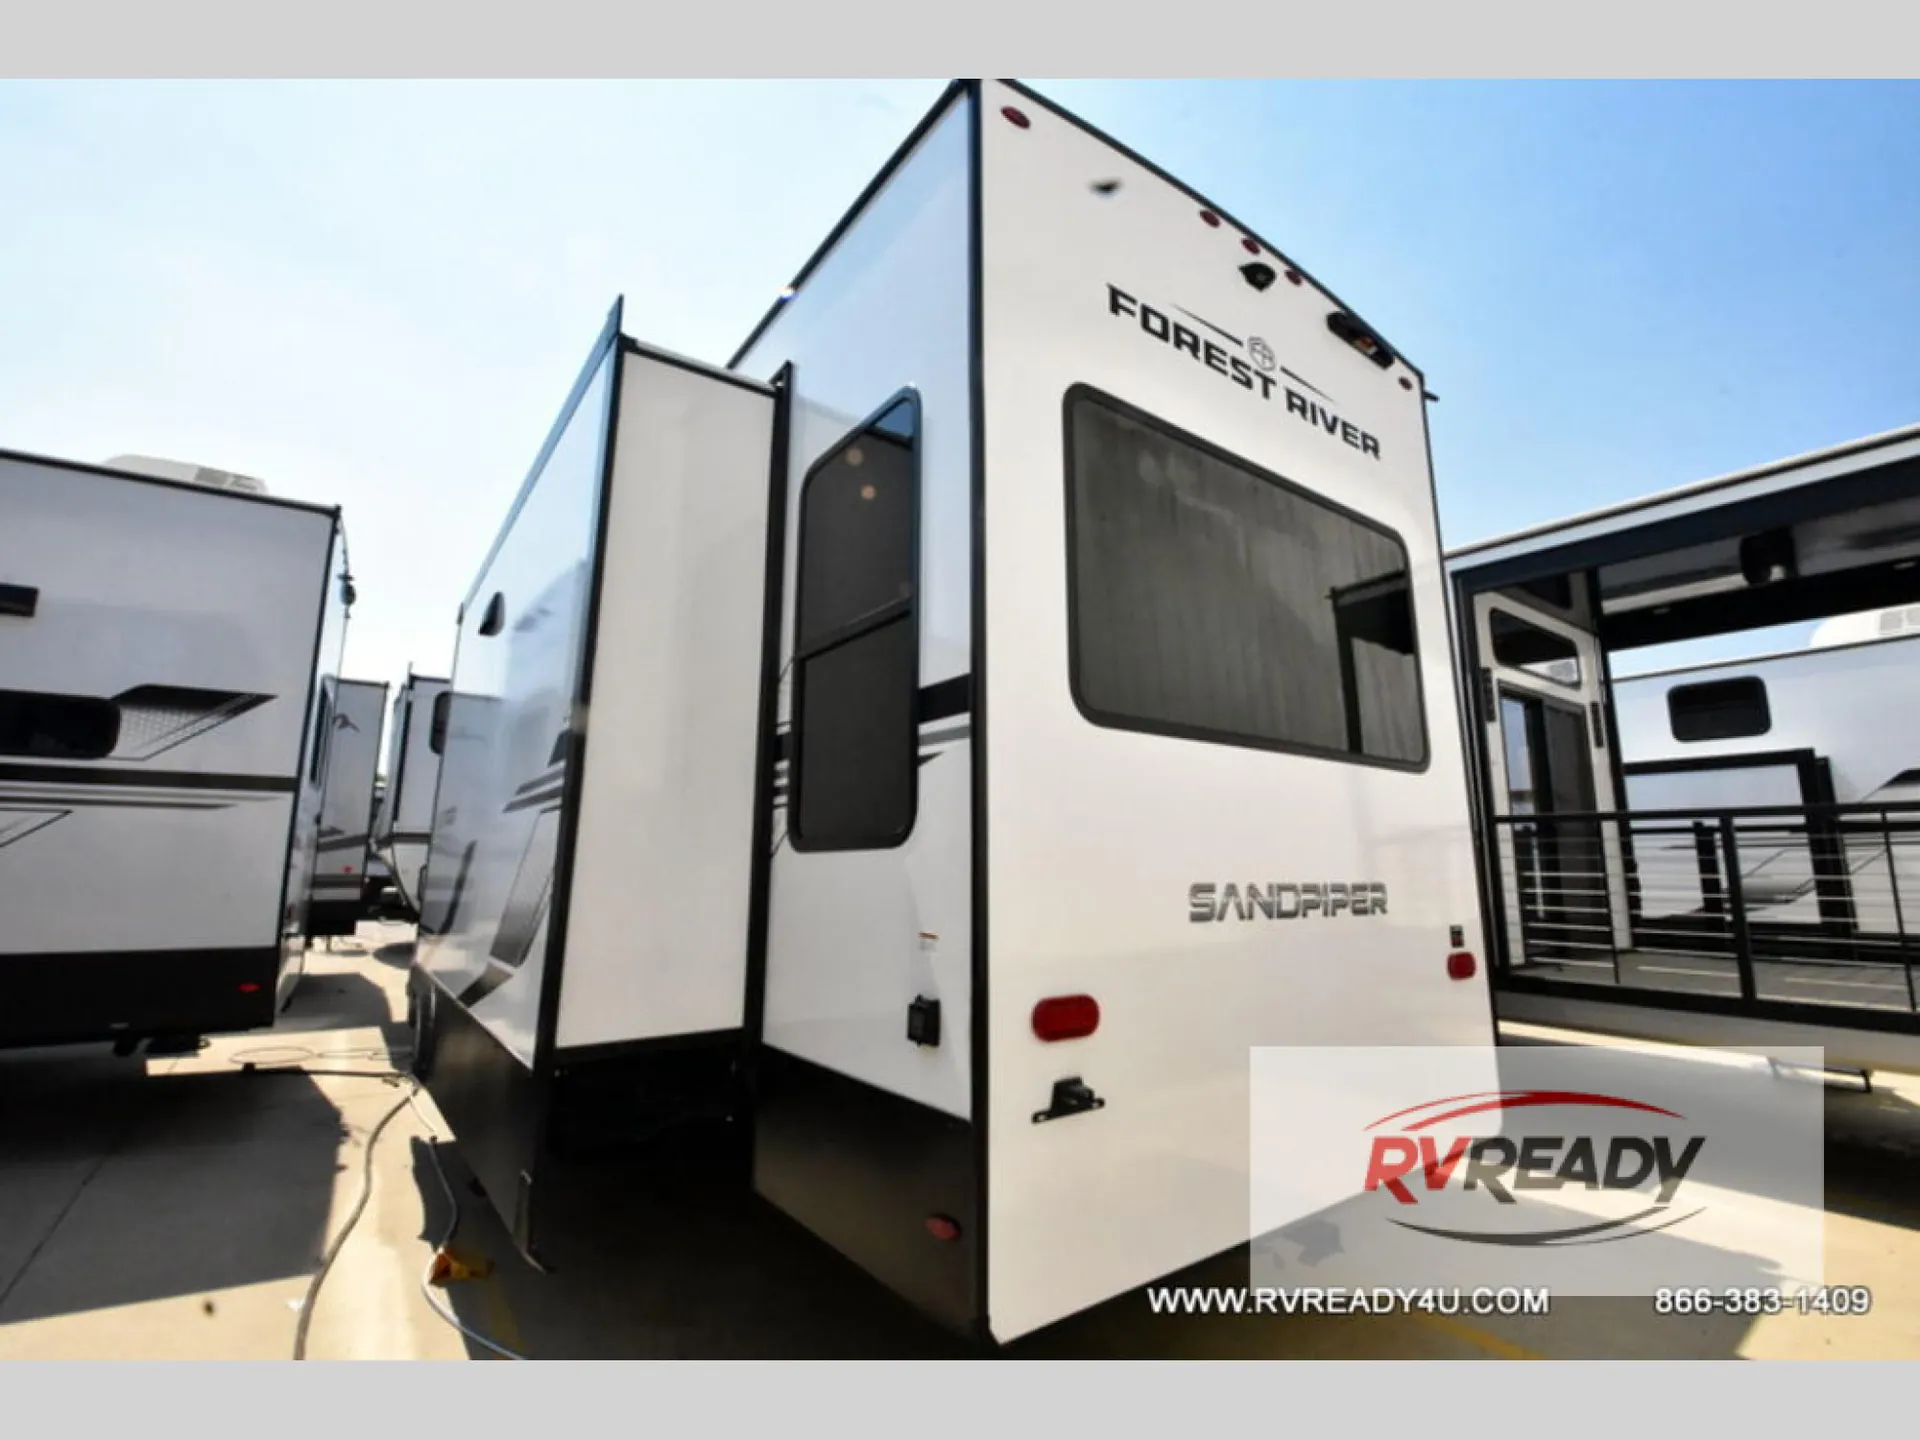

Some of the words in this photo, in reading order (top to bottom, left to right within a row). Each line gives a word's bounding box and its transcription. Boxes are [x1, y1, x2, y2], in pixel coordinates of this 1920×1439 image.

[1107, 284, 1277, 399] FOREST
[1285, 388, 1380, 459] RIVER
[1189, 883, 1387, 922] SANDPIPER
